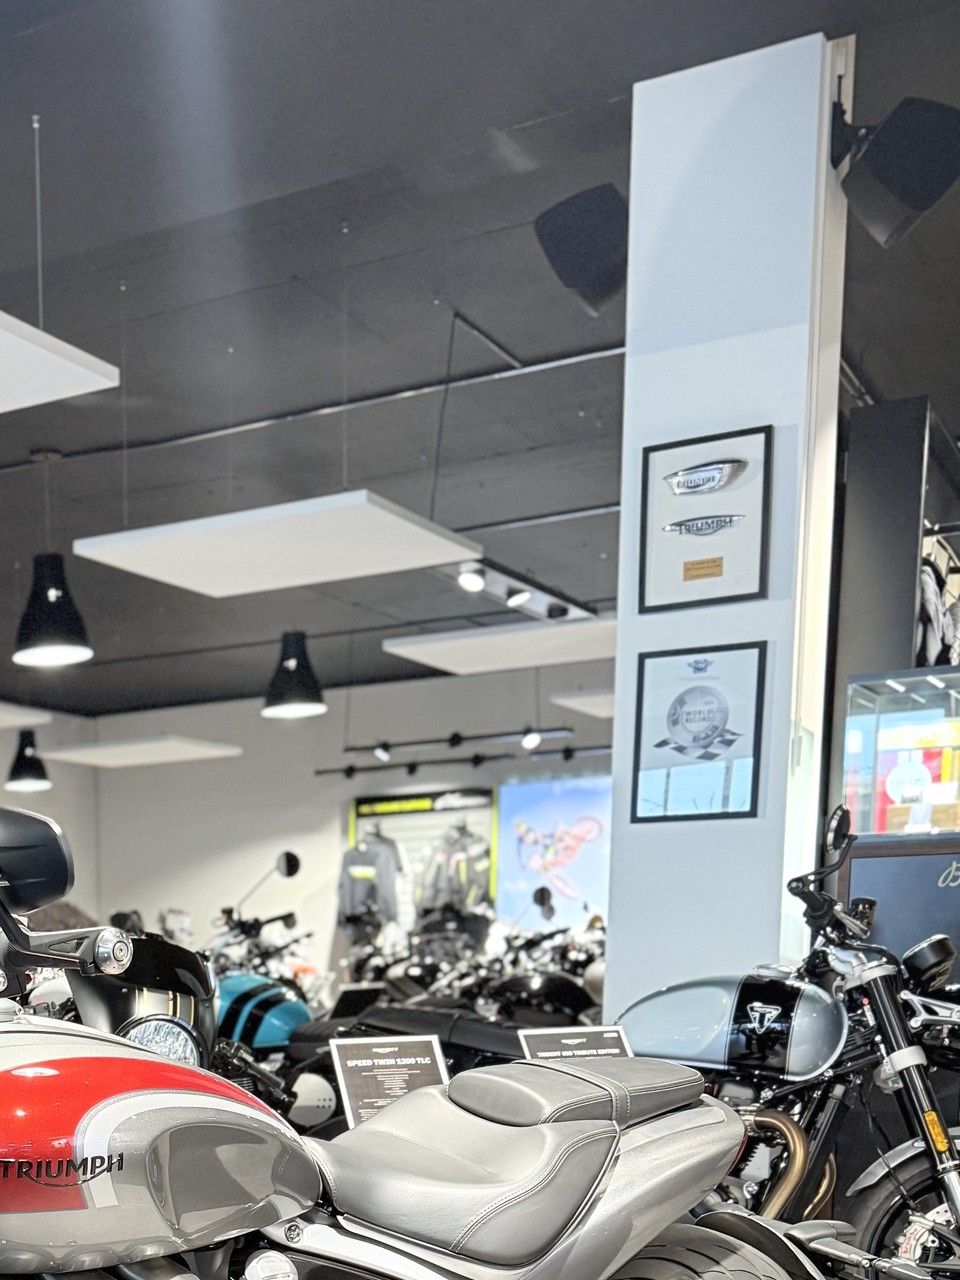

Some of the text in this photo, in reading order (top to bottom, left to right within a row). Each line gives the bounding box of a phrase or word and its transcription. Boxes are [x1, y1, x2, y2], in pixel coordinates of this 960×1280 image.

[677, 516, 733, 536] TRIUMPH
[685, 709, 712, 717] WORLD
[346, 1056, 432, 1067] SPEED TWIN 1200 TLC
